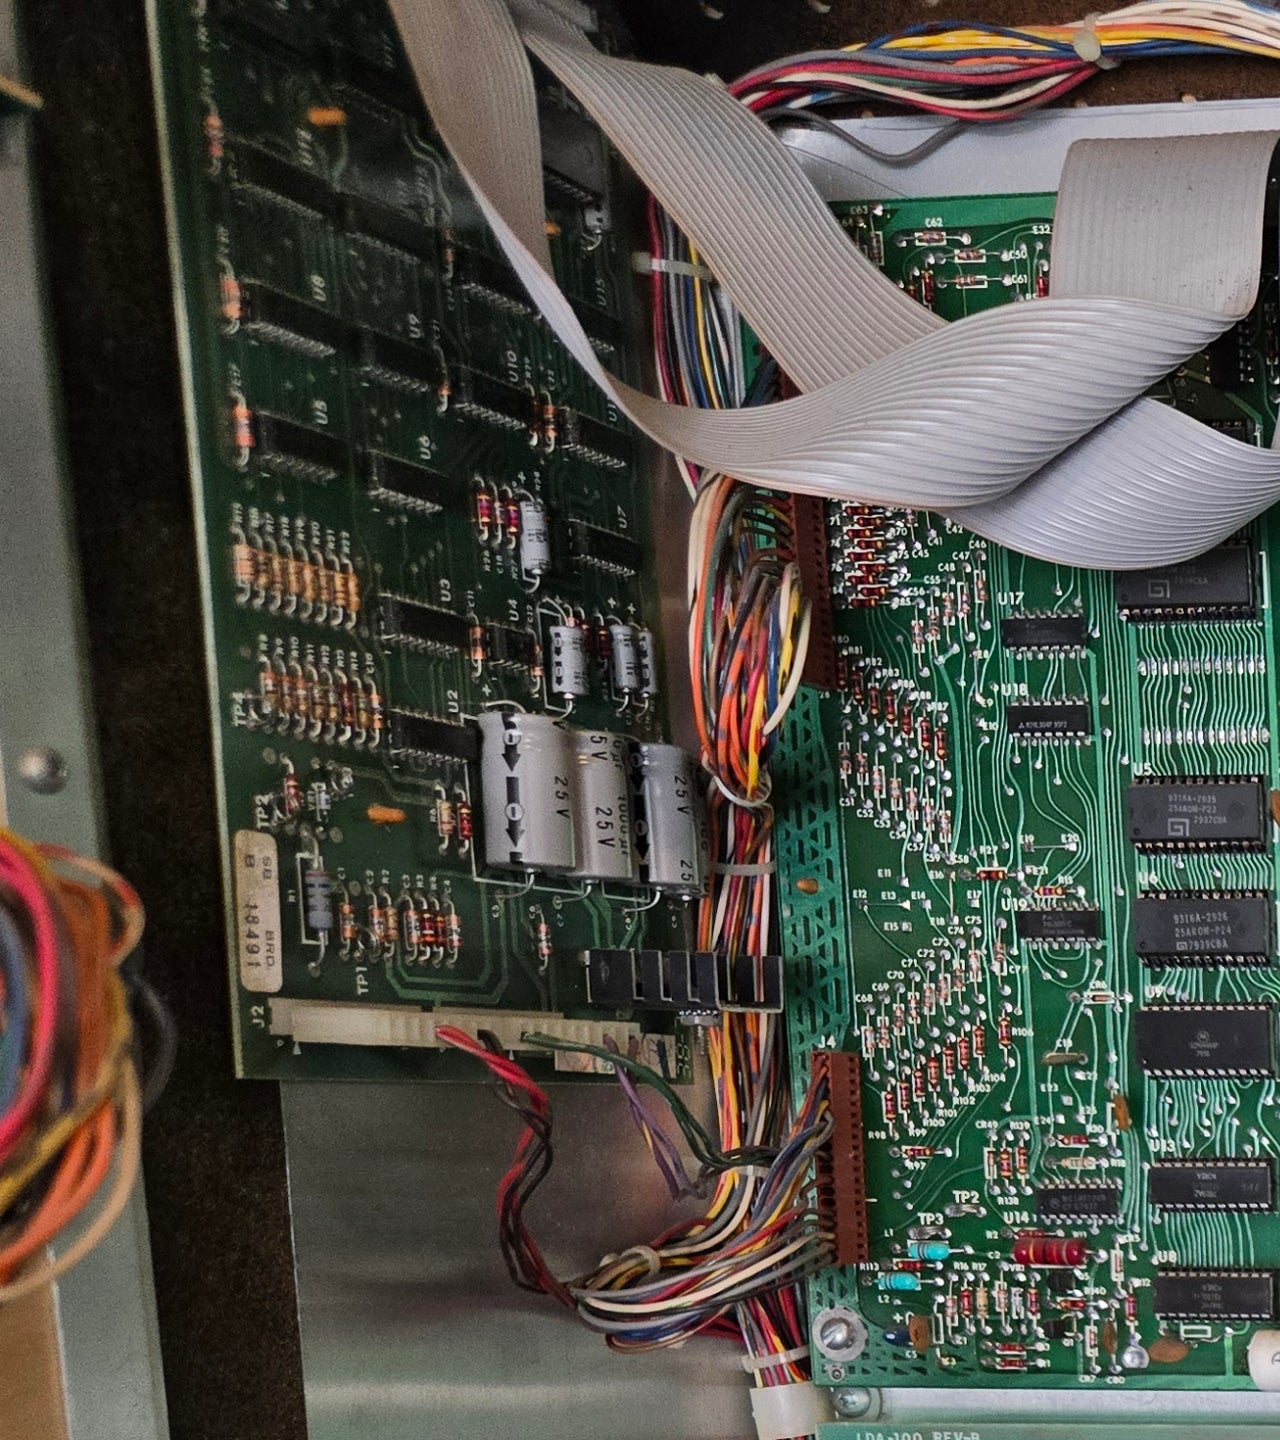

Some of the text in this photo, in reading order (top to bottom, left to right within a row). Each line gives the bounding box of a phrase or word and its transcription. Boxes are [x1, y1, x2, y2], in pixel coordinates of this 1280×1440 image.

[997, 590, 1025, 610] U17
[1000, 678, 1030, 701] U18
[952, 1189, 980, 1204] TP2
[916, 1211, 944, 1226] TP3
